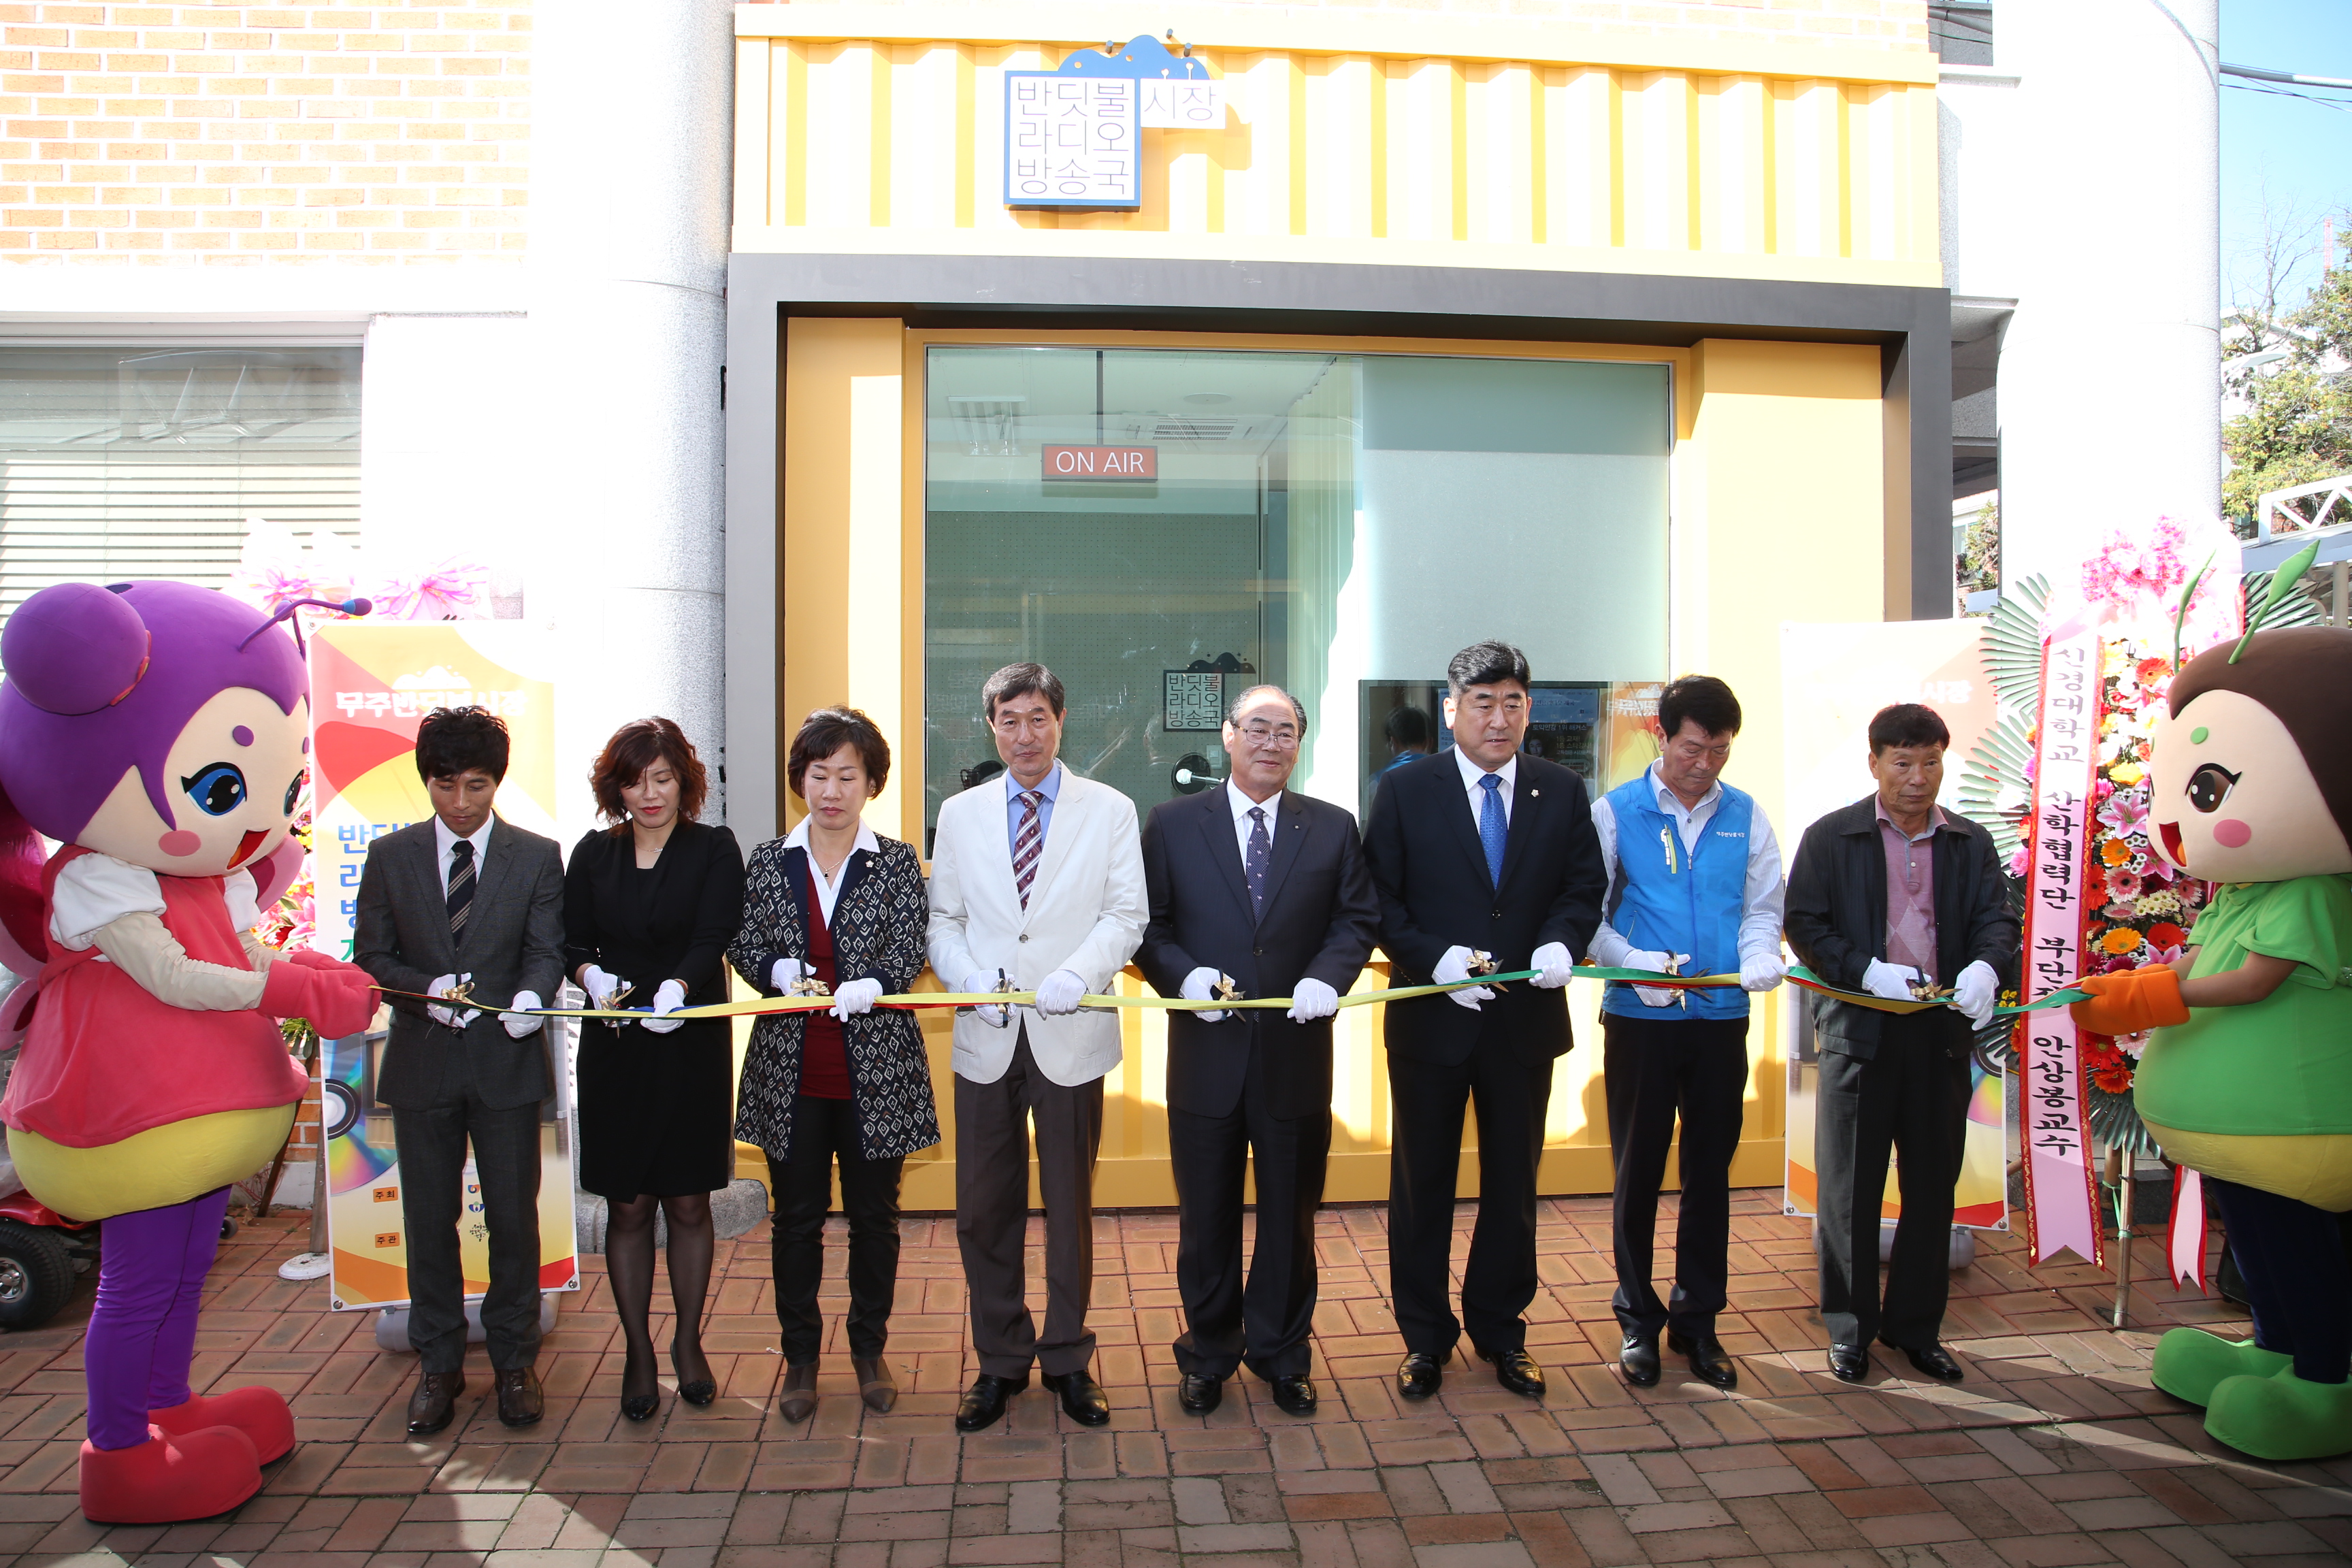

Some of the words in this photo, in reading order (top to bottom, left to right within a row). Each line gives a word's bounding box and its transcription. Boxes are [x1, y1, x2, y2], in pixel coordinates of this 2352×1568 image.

[1017, 80, 1129, 118] 반딧불
[1143, 84, 1217, 121] 시장
[1018, 118, 1129, 156] 라디오
[1017, 157, 1129, 195] 방송국
[1056, 451, 1094, 473] ON
[1102, 451, 1145, 474] AIR
[1169, 674, 1220, 691] 반딧불
[1169, 691, 1220, 709] 라디오
[1169, 709, 1220, 728] 방송국
[2046, 647, 2086, 763] 신경대학교
[2039, 789, 2082, 911] 산학협력단
[2029, 1034, 2080, 1157] 안상봉교수
